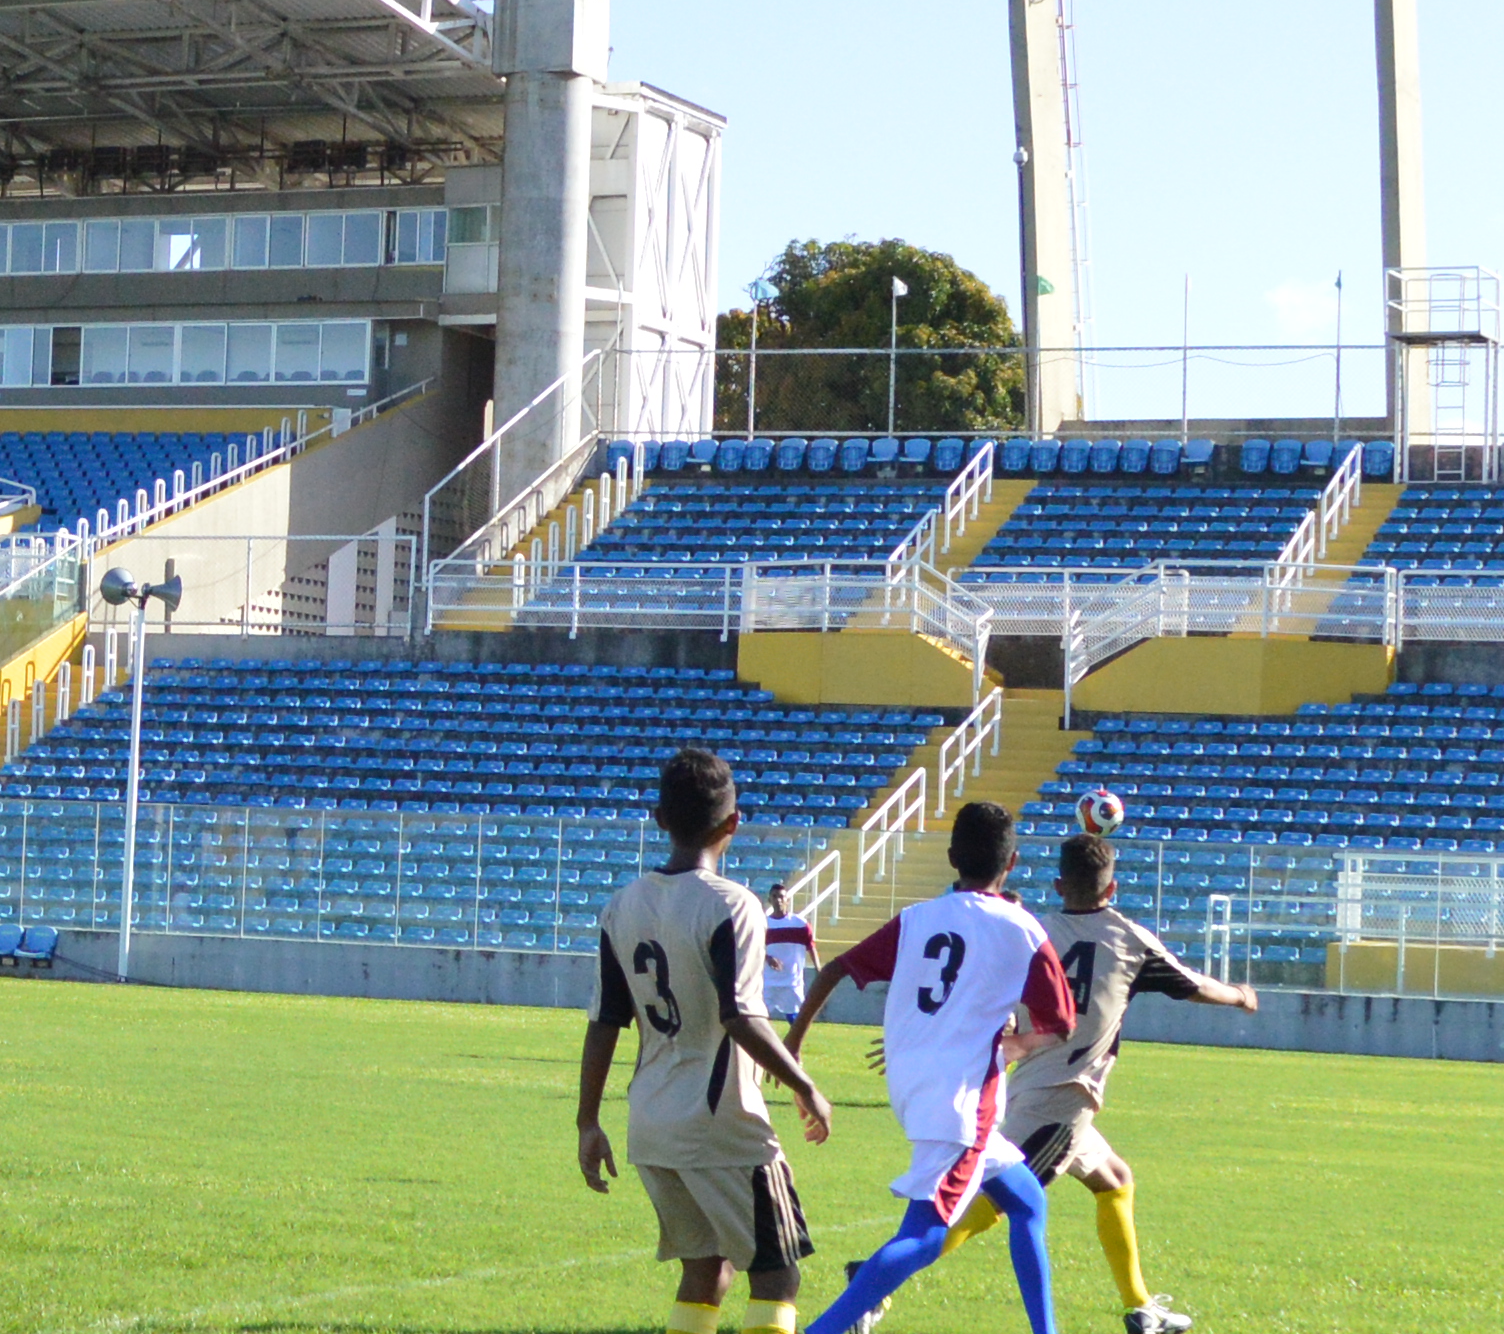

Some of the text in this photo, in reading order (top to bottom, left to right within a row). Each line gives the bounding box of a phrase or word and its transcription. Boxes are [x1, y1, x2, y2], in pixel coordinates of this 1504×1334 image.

[633, 939, 682, 1039] 3
[917, 931, 966, 1016] 3
[1061, 940, 1097, 1015] 4
